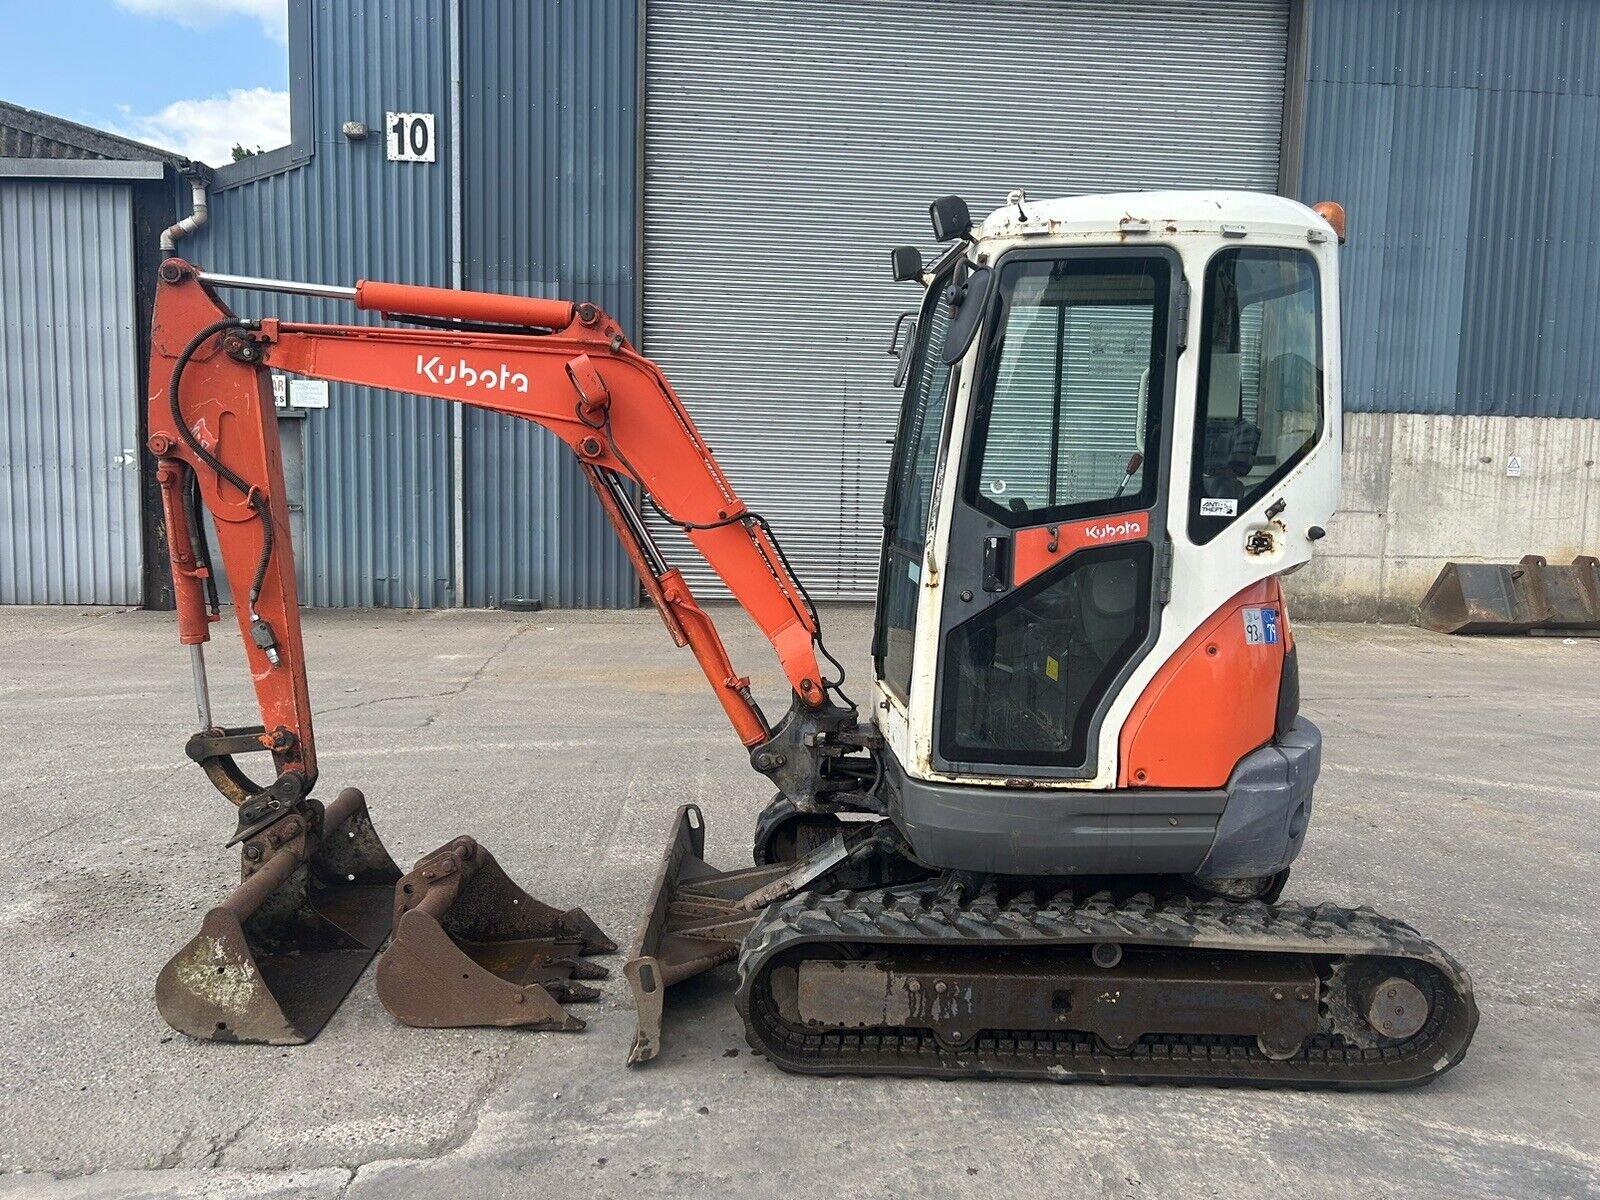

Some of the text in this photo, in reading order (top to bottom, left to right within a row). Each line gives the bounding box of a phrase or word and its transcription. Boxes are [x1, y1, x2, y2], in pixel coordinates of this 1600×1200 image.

[393, 117, 428, 156] 10
[416, 354, 529, 393] Kubota
[1085, 521, 1140, 539] Kubota
[1246, 624, 1259, 642] 93
